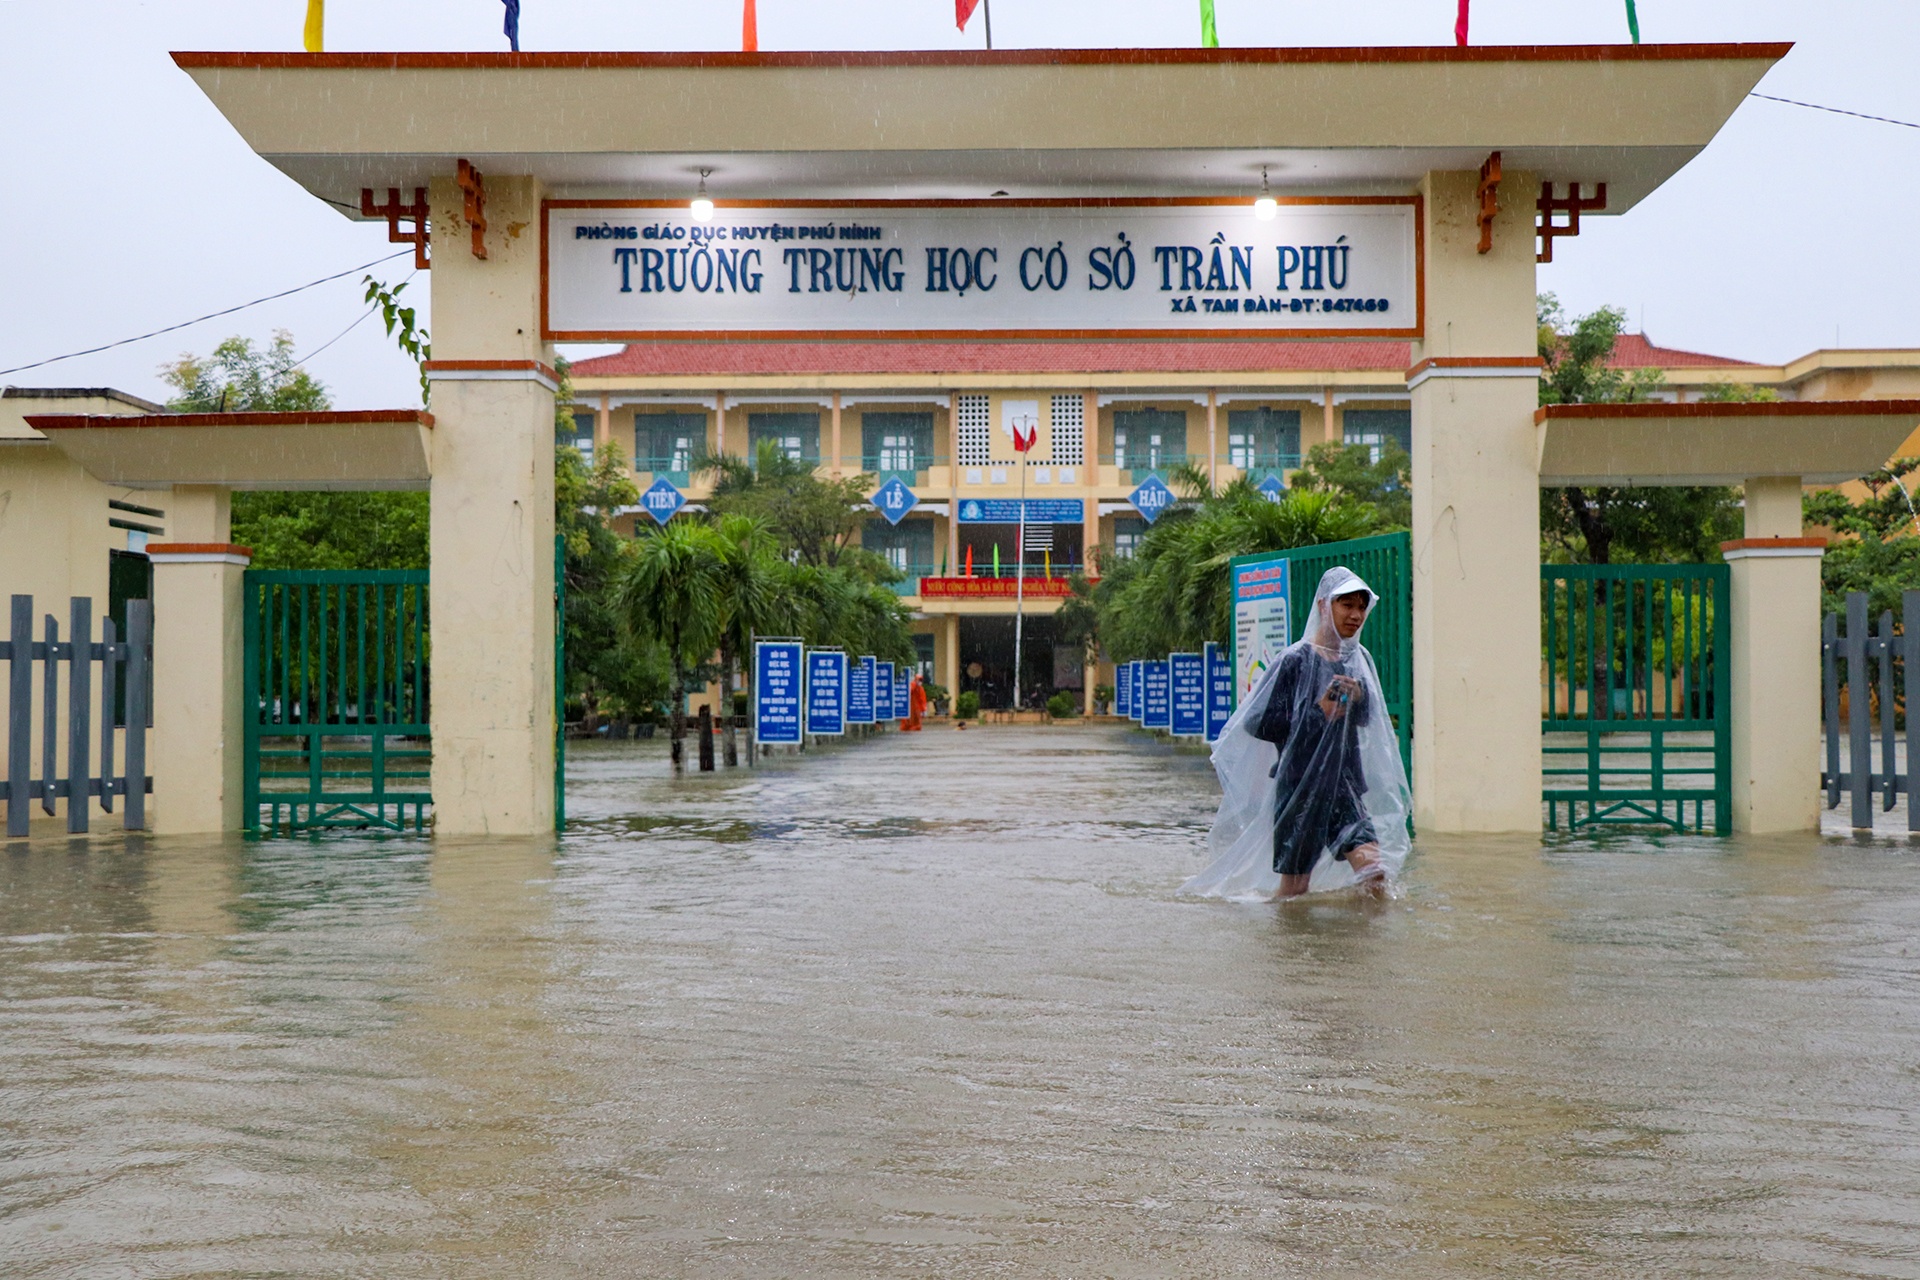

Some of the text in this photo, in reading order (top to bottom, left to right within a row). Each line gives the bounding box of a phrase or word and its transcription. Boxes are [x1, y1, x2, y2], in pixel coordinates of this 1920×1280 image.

[575, 222, 638, 240] PHÒNG
[690, 226, 727, 242] DỤC
[732, 223, 795, 242] HUYỆN
[798, 222, 835, 240] PHÚ
[614, 231, 1350, 297] TRƯỜNG TRUNG HỌC CƠ SỞ TRẦN PHÚ
[1171, 296, 1198, 313] XÃ
[1202, 298, 1239, 313] TAM
[1138, 485, 1167, 511] HẬU
